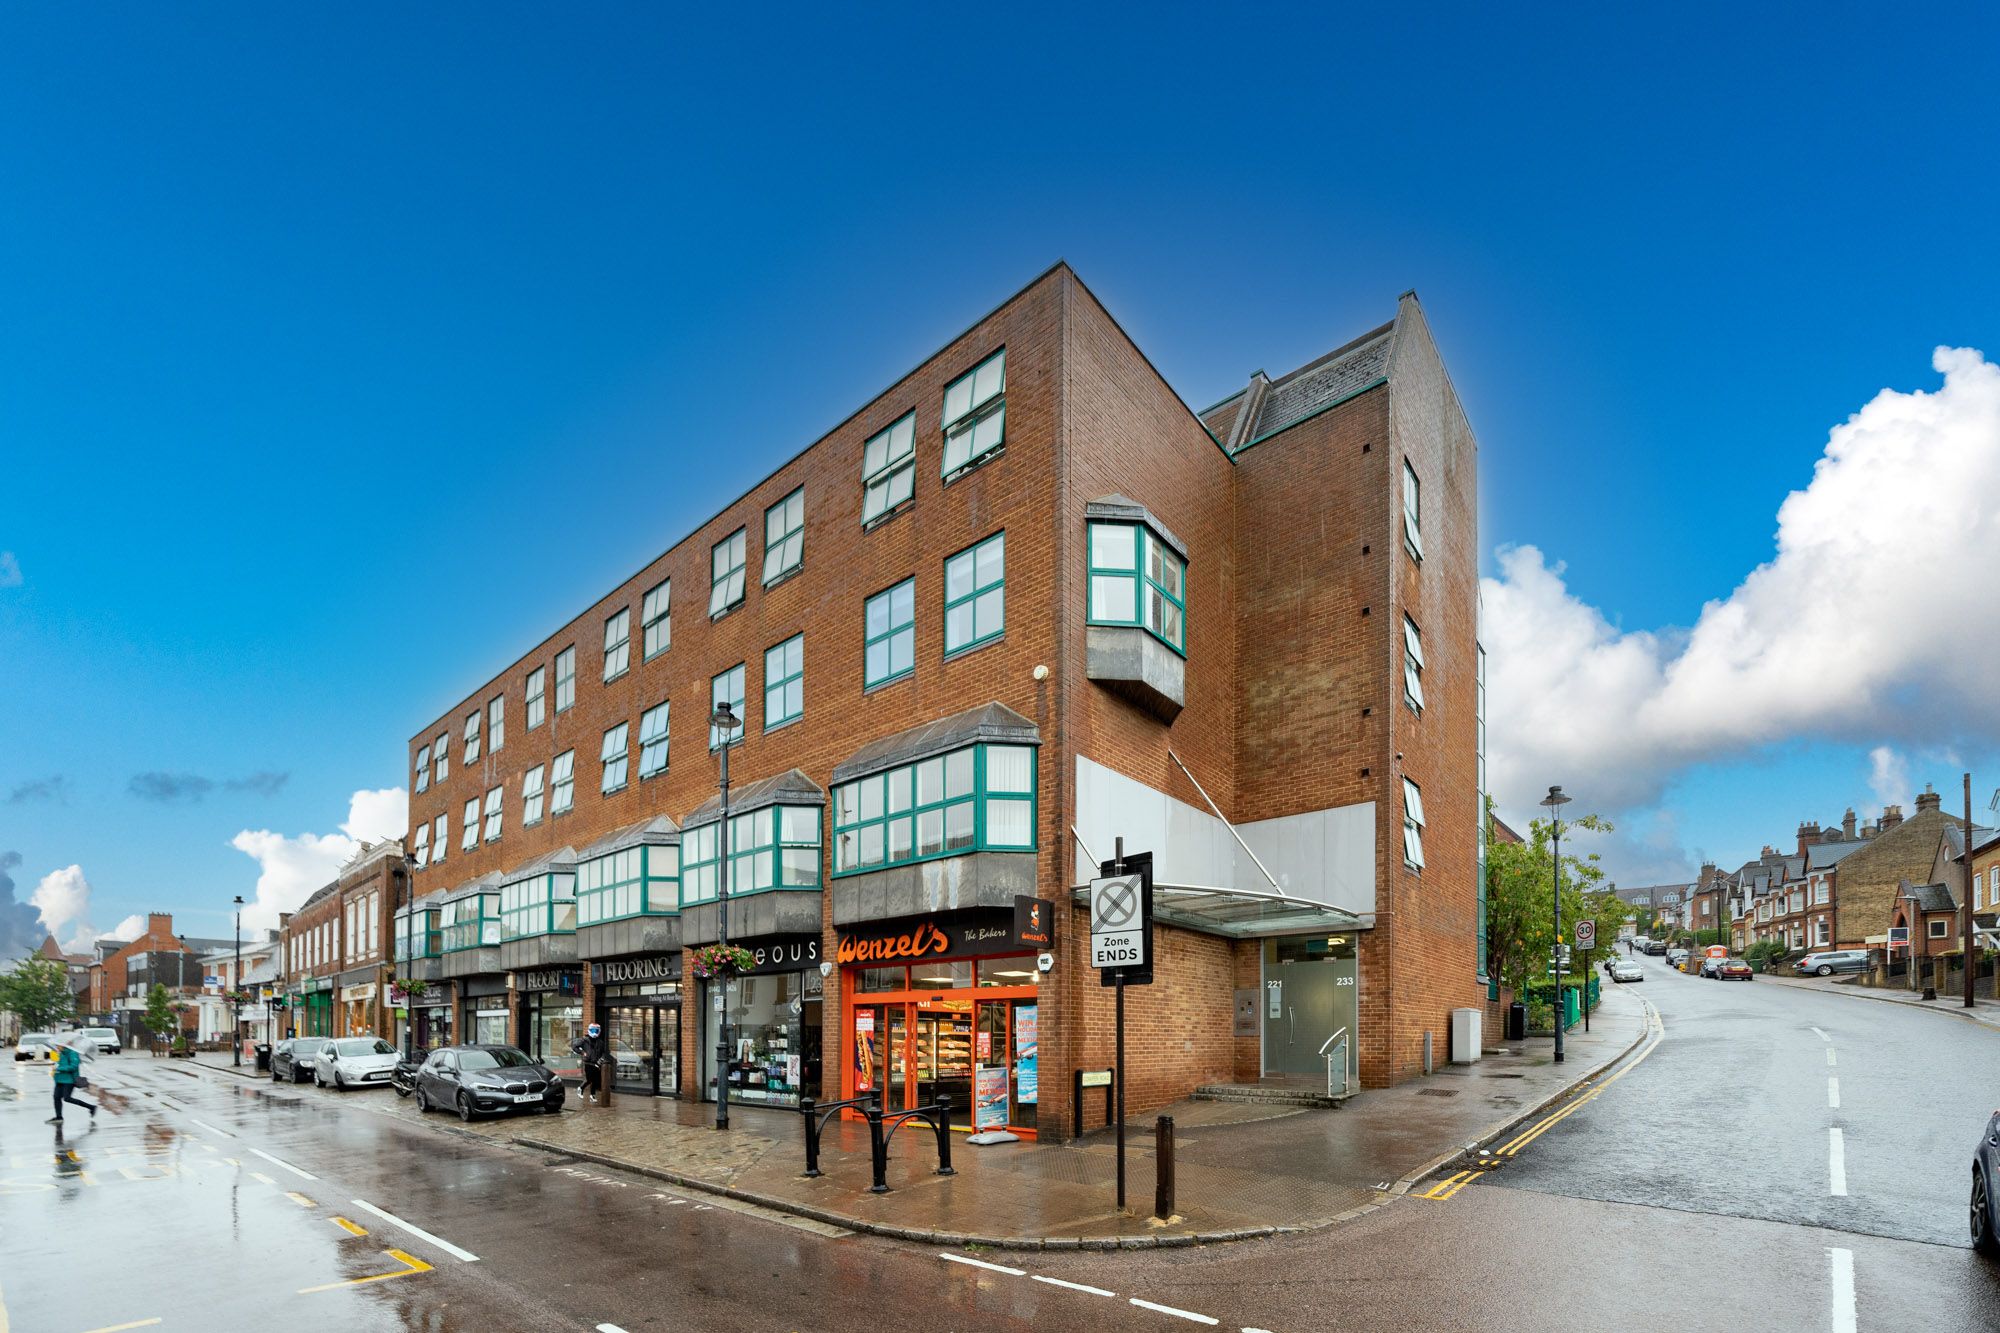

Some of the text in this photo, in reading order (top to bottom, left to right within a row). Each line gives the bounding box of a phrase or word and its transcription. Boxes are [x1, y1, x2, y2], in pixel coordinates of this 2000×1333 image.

[965, 928, 1007, 942] The Bakers
[1580, 926, 1591, 934] 30
[838, 922, 948, 963] Wenzel's
[1104, 937, 1130, 947] Zone
[1097, 948, 1138, 962] ENDS
[606, 957, 669, 982] FLOORING
[527, 971, 559, 989] FLOORI
[1267, 980, 1282, 988] 221
[1336, 977, 1354, 986] 233
